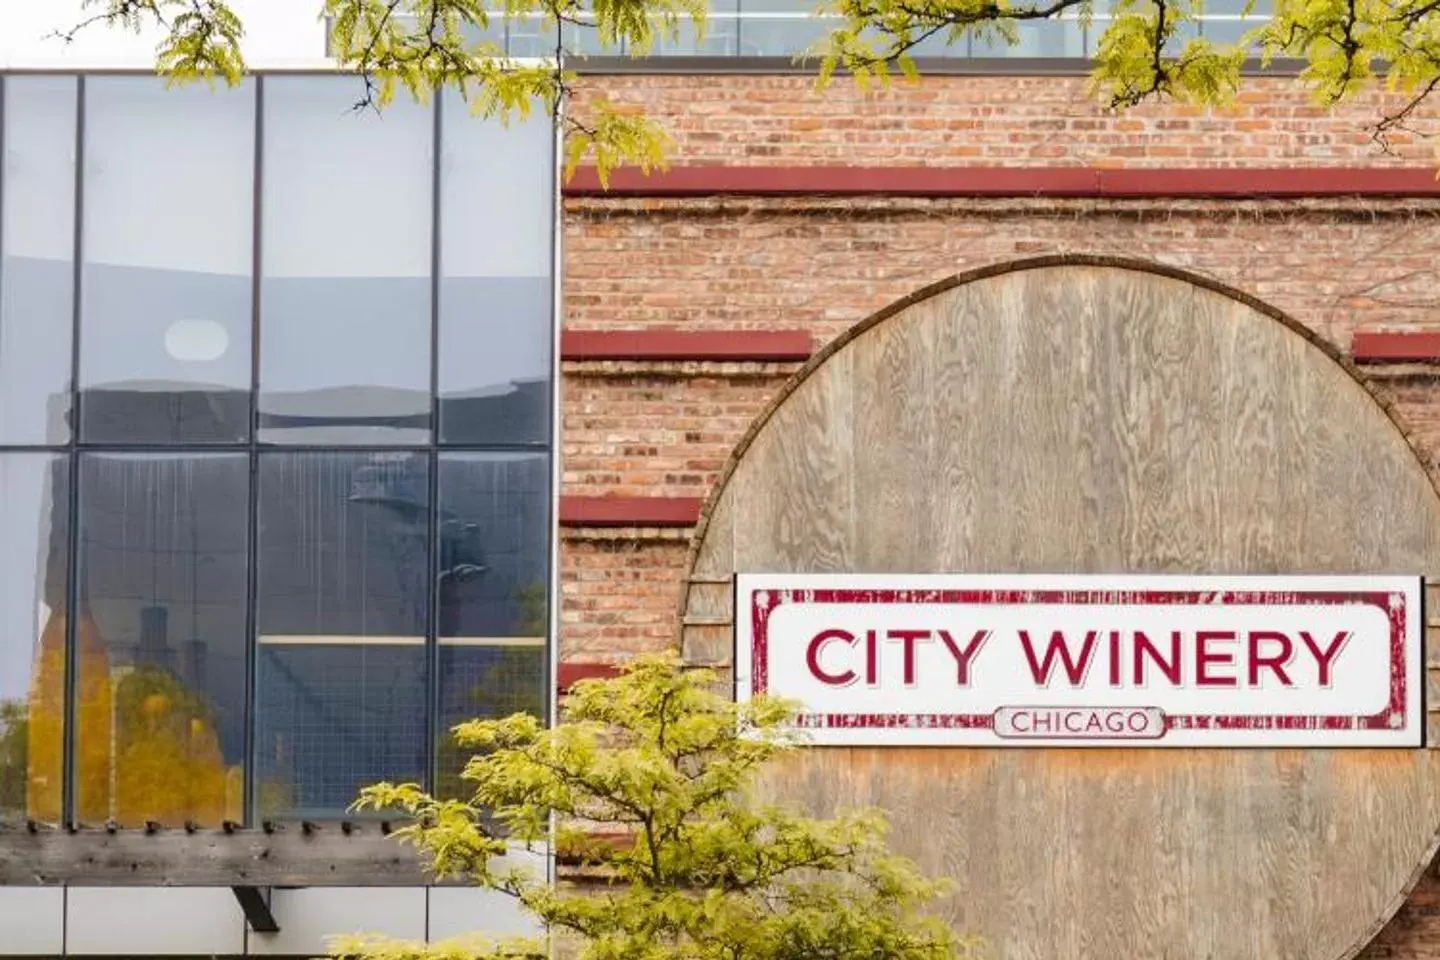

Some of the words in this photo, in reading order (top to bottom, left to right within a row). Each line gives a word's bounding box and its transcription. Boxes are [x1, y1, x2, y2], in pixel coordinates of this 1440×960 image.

[806, 629, 991, 688] CITY
[1018, 630, 1353, 688] WINERY
[1010, 711, 1150, 733] CHICAGO
